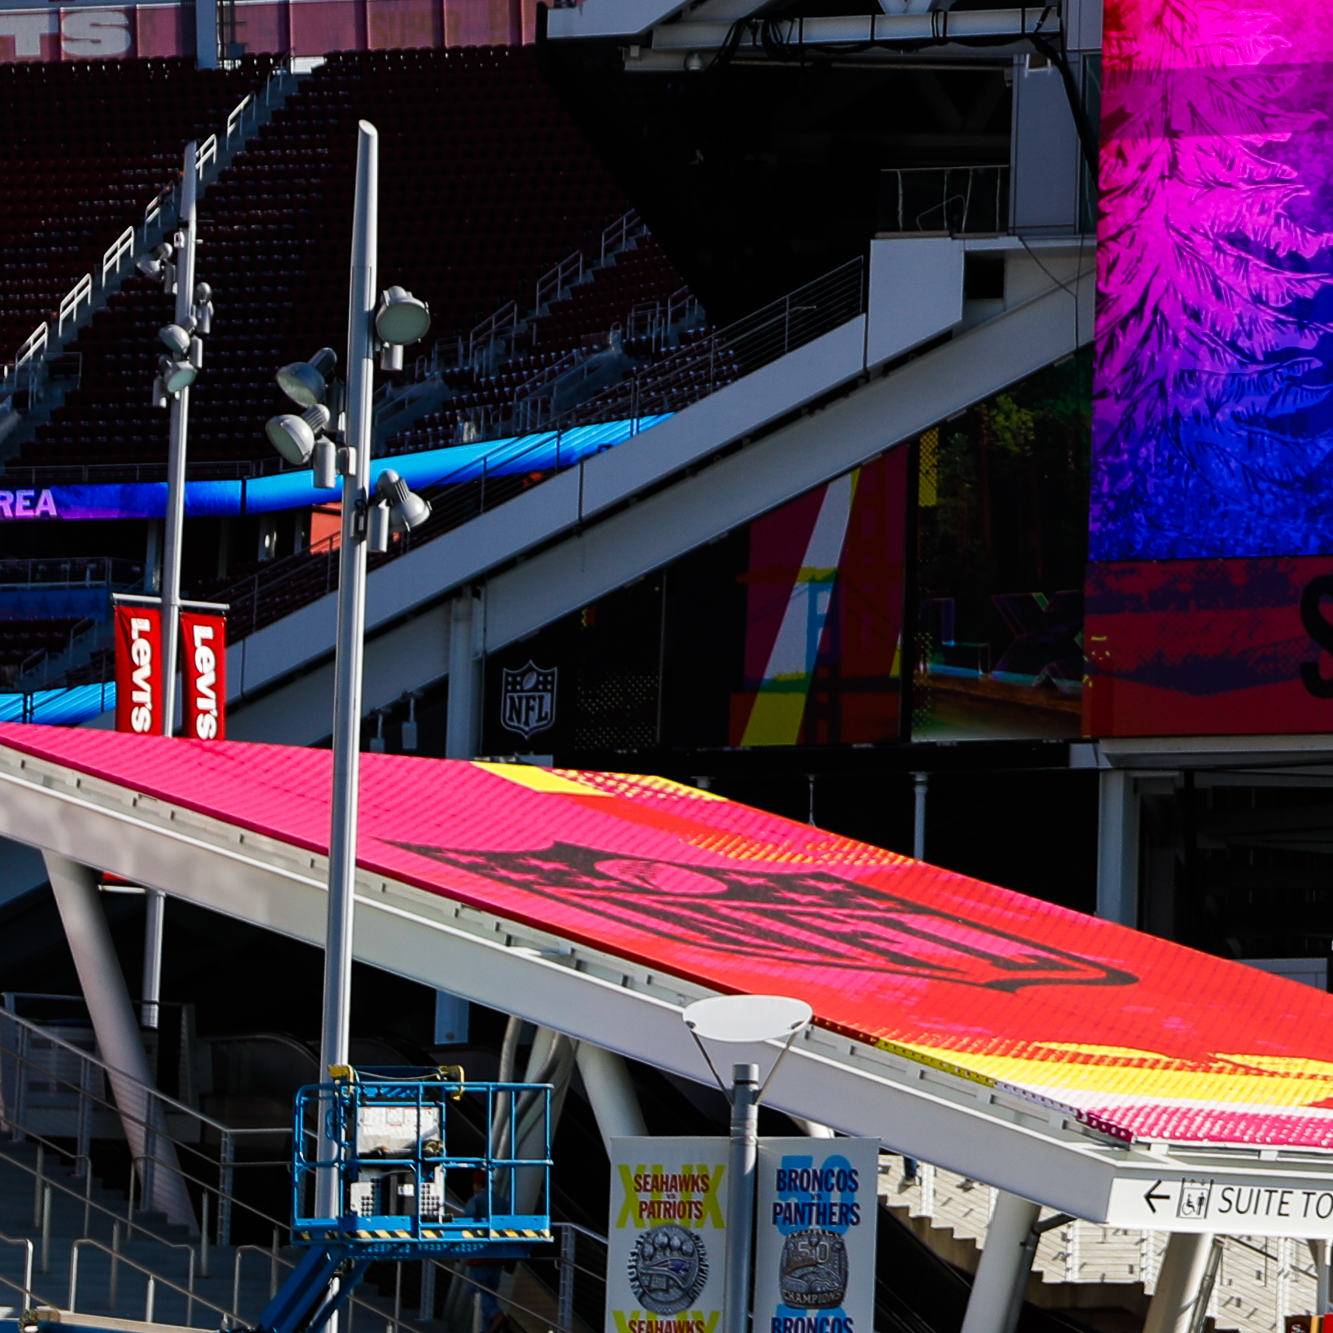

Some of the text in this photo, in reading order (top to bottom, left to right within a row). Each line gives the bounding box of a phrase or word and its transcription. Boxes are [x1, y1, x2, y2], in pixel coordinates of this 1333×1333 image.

[506, 694, 551, 727] NFL
[633, 1174, 710, 1193] SEAHAWKS
[776, 1168, 859, 1192] BRONCOS
[639, 1200, 703, 1219] PATRIOTS
[1218, 1187, 1294, 1217] SUITE
[772, 1202, 861, 1226] PANTHERS
[628, 1320, 705, 1333] SEAHAWKS
[771, 1317, 854, 1333] BRONCOS
